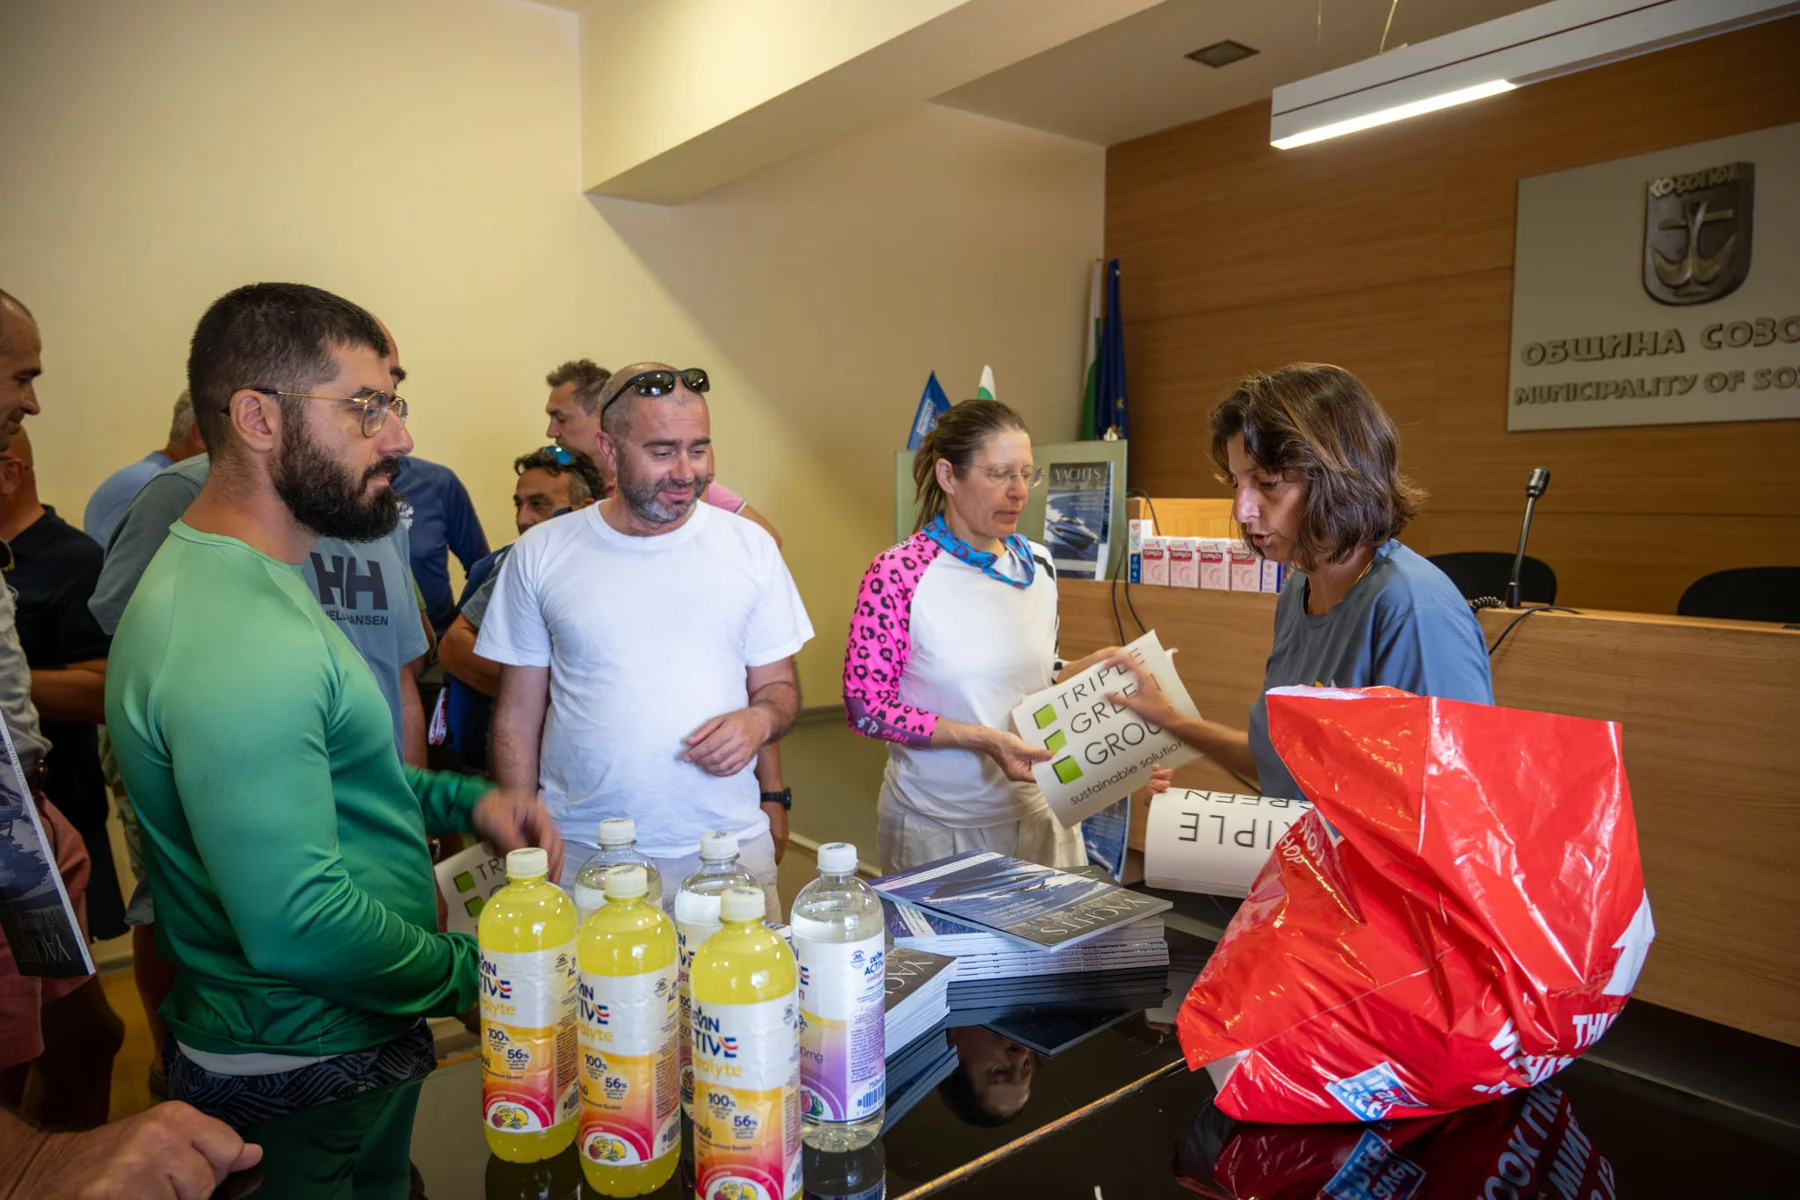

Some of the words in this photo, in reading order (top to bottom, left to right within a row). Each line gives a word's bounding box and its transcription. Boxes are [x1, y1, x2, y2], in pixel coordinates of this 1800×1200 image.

[1521, 328, 1685, 367] ОБЩИНА
[1514, 374, 1697, 405] MUNICIPALITY
[1703, 370, 1745, 393] OF
[1752, 366, 1800, 391] SO
[1055, 467, 1101, 481] YACHTS
[310, 552, 388, 611] HH
[344, 614, 388, 626] ANSEN
[1084, 717, 1163, 765] GROU
[1070, 766, 1138, 805] sustainable
[1179, 812, 1291, 850] IPLE
[1040, 898, 1150, 936] YACHTS
[885, 961, 933, 995] YAC
